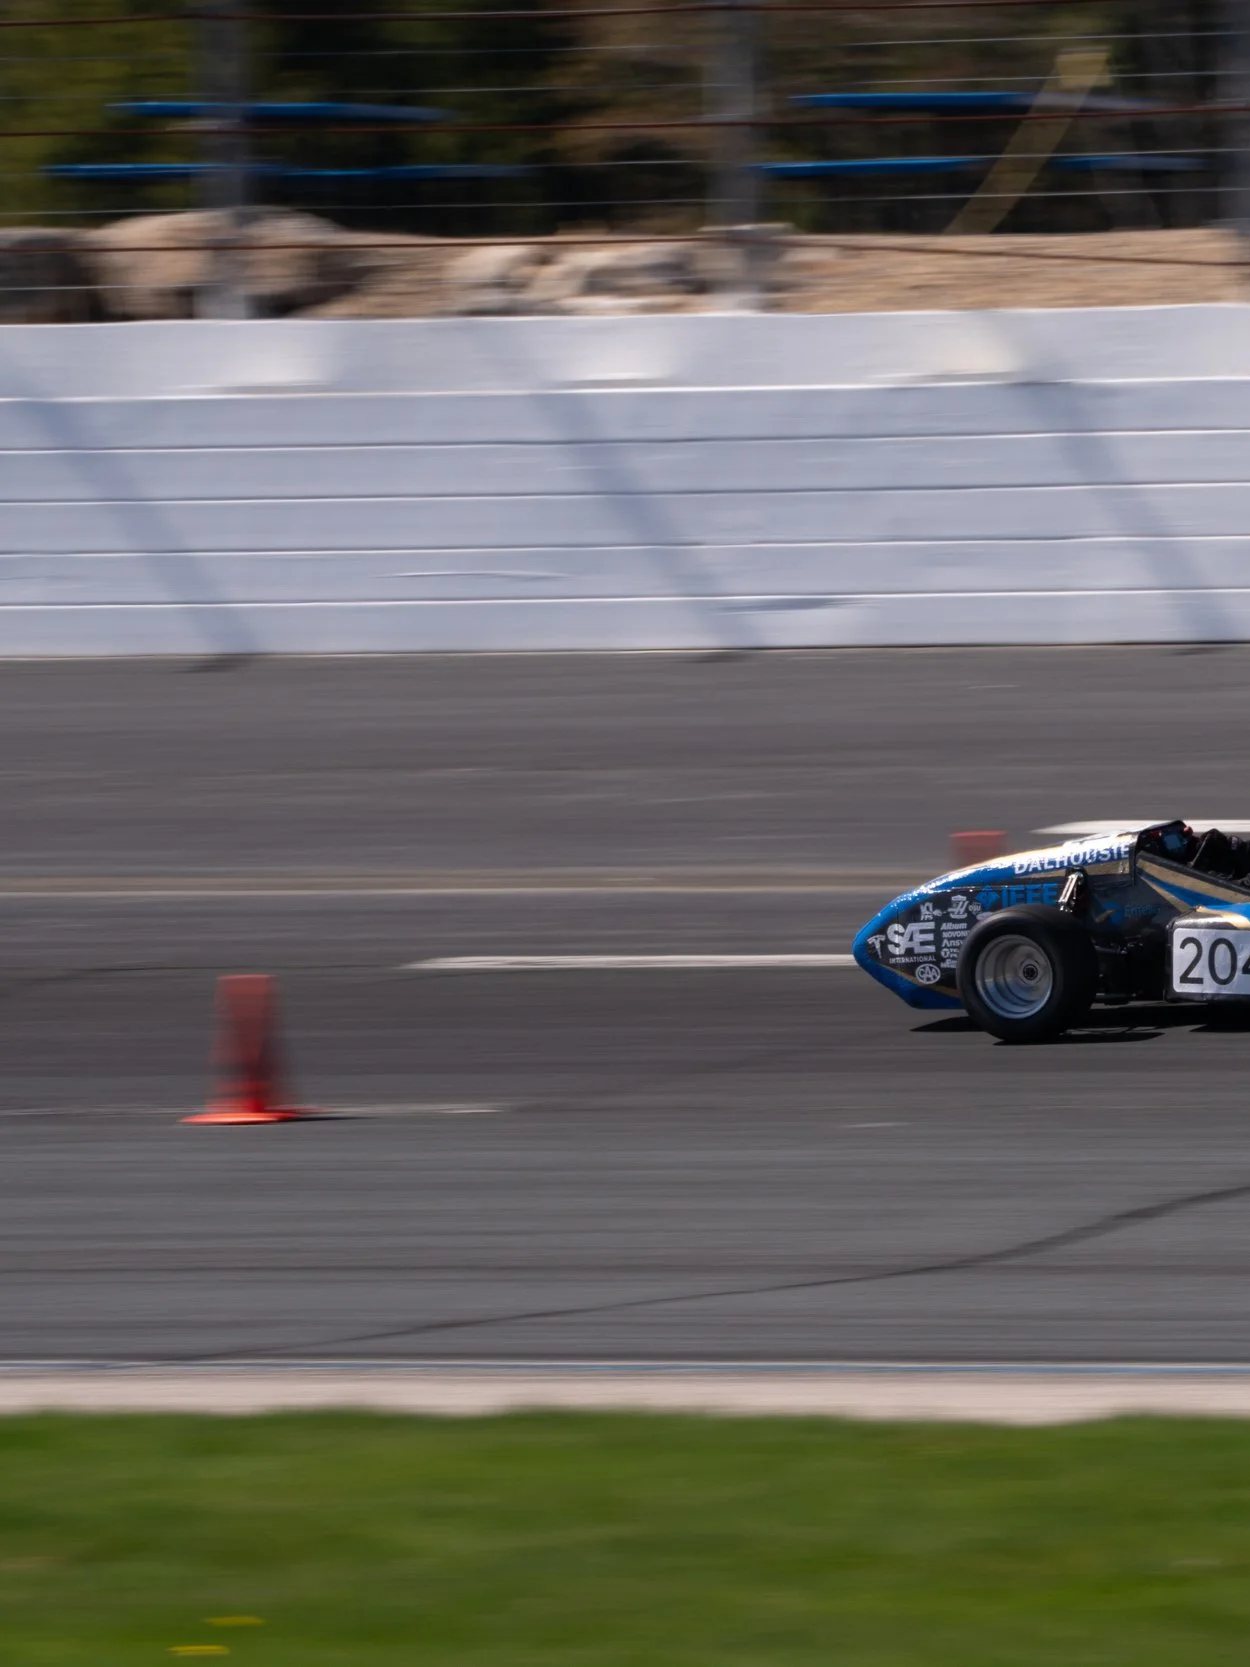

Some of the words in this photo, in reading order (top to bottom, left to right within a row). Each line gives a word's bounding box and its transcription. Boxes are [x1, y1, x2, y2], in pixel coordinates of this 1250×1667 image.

[1014, 843, 1130, 875] DALHOUSIE
[1002, 884, 1057, 908] IEEE
[940, 922, 967, 930] Album
[887, 922, 935, 955] SAE
[889, 955, 936, 964] INTERNATIONAL
[918, 965, 938, 982] CAA
